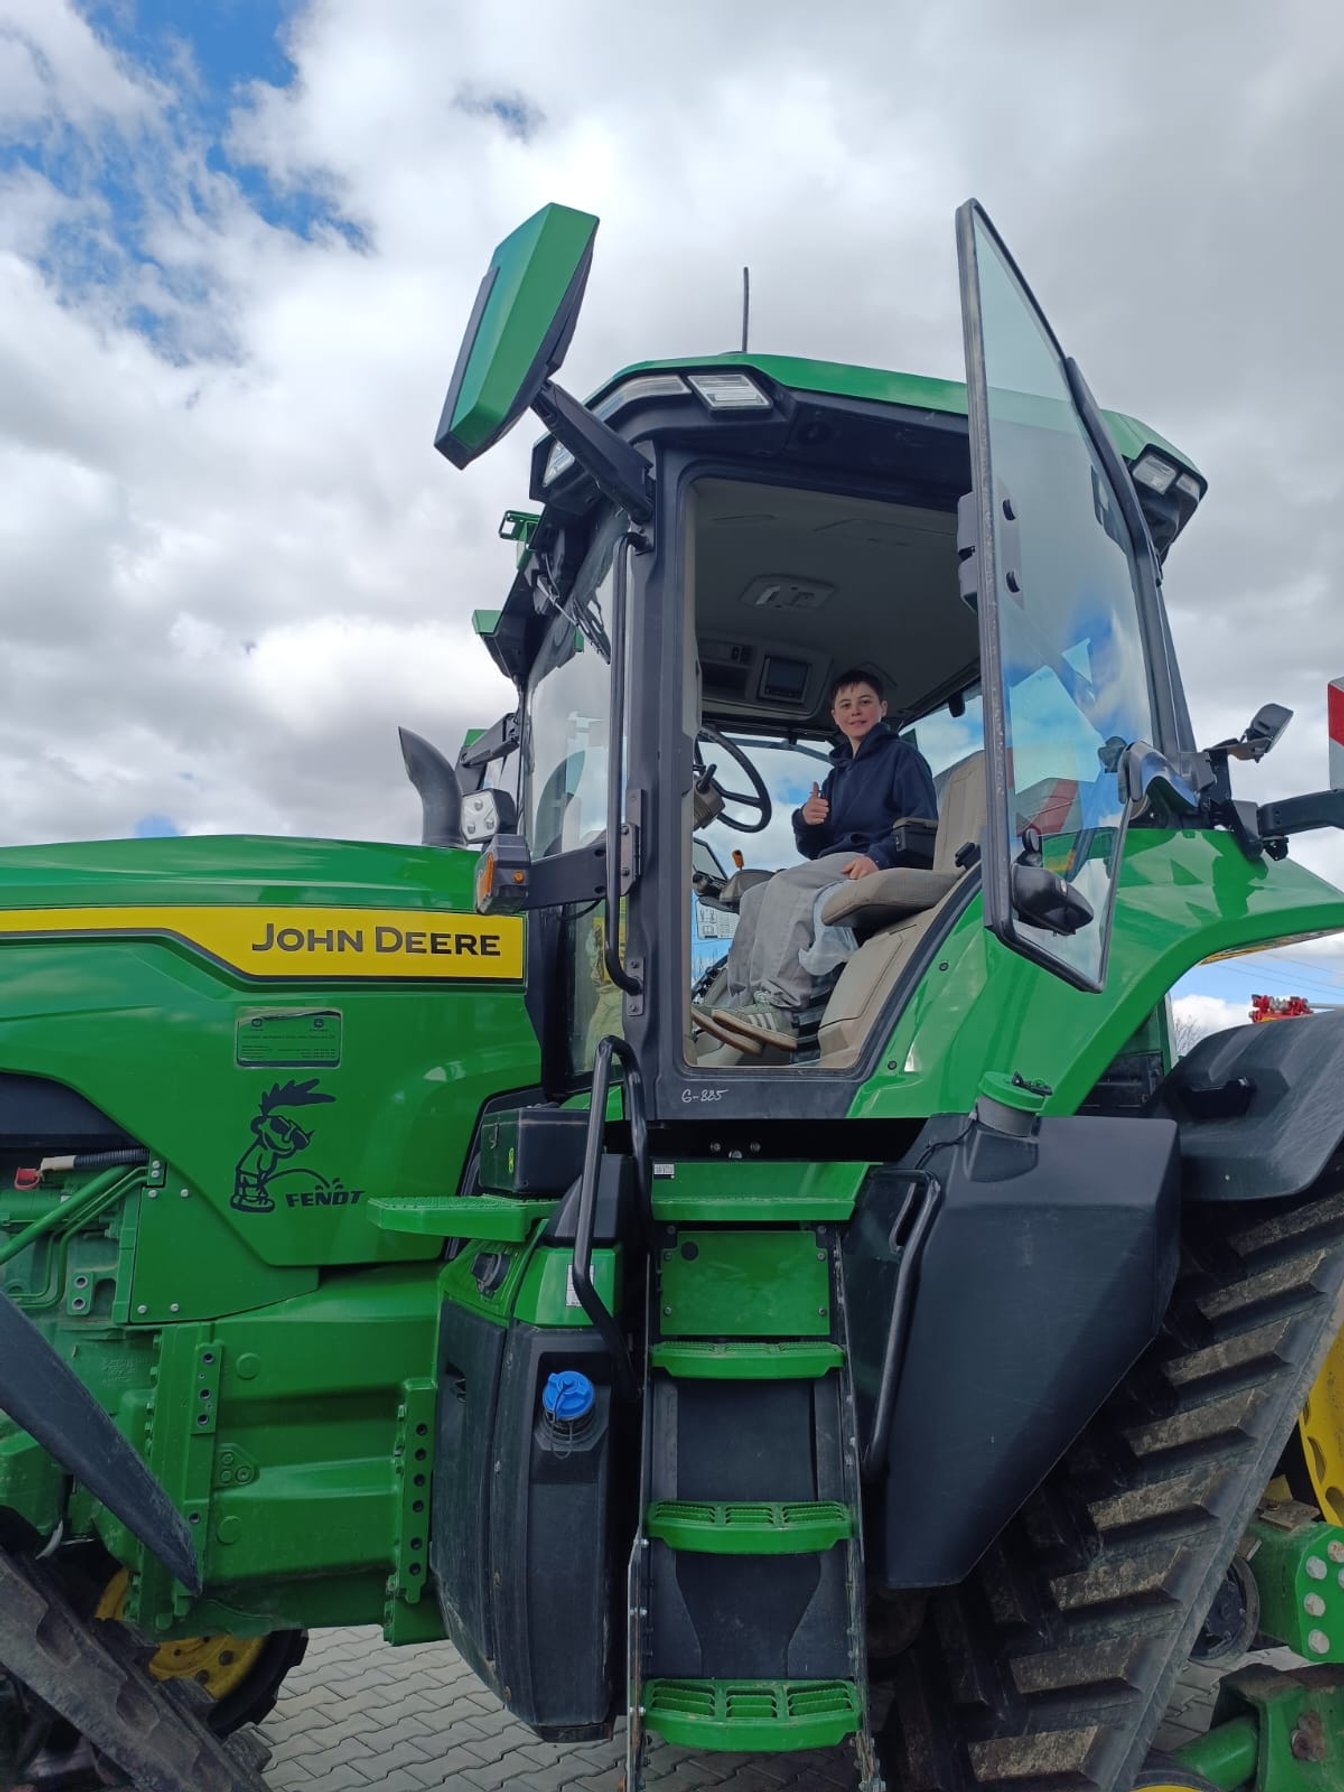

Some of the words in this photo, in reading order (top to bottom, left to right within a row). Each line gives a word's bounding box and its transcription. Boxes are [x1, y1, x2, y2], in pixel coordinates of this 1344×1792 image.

[252, 923, 363, 952] JOHN
[375, 926, 501, 956] DEERE
[285, 1190, 366, 1208] FENDT
